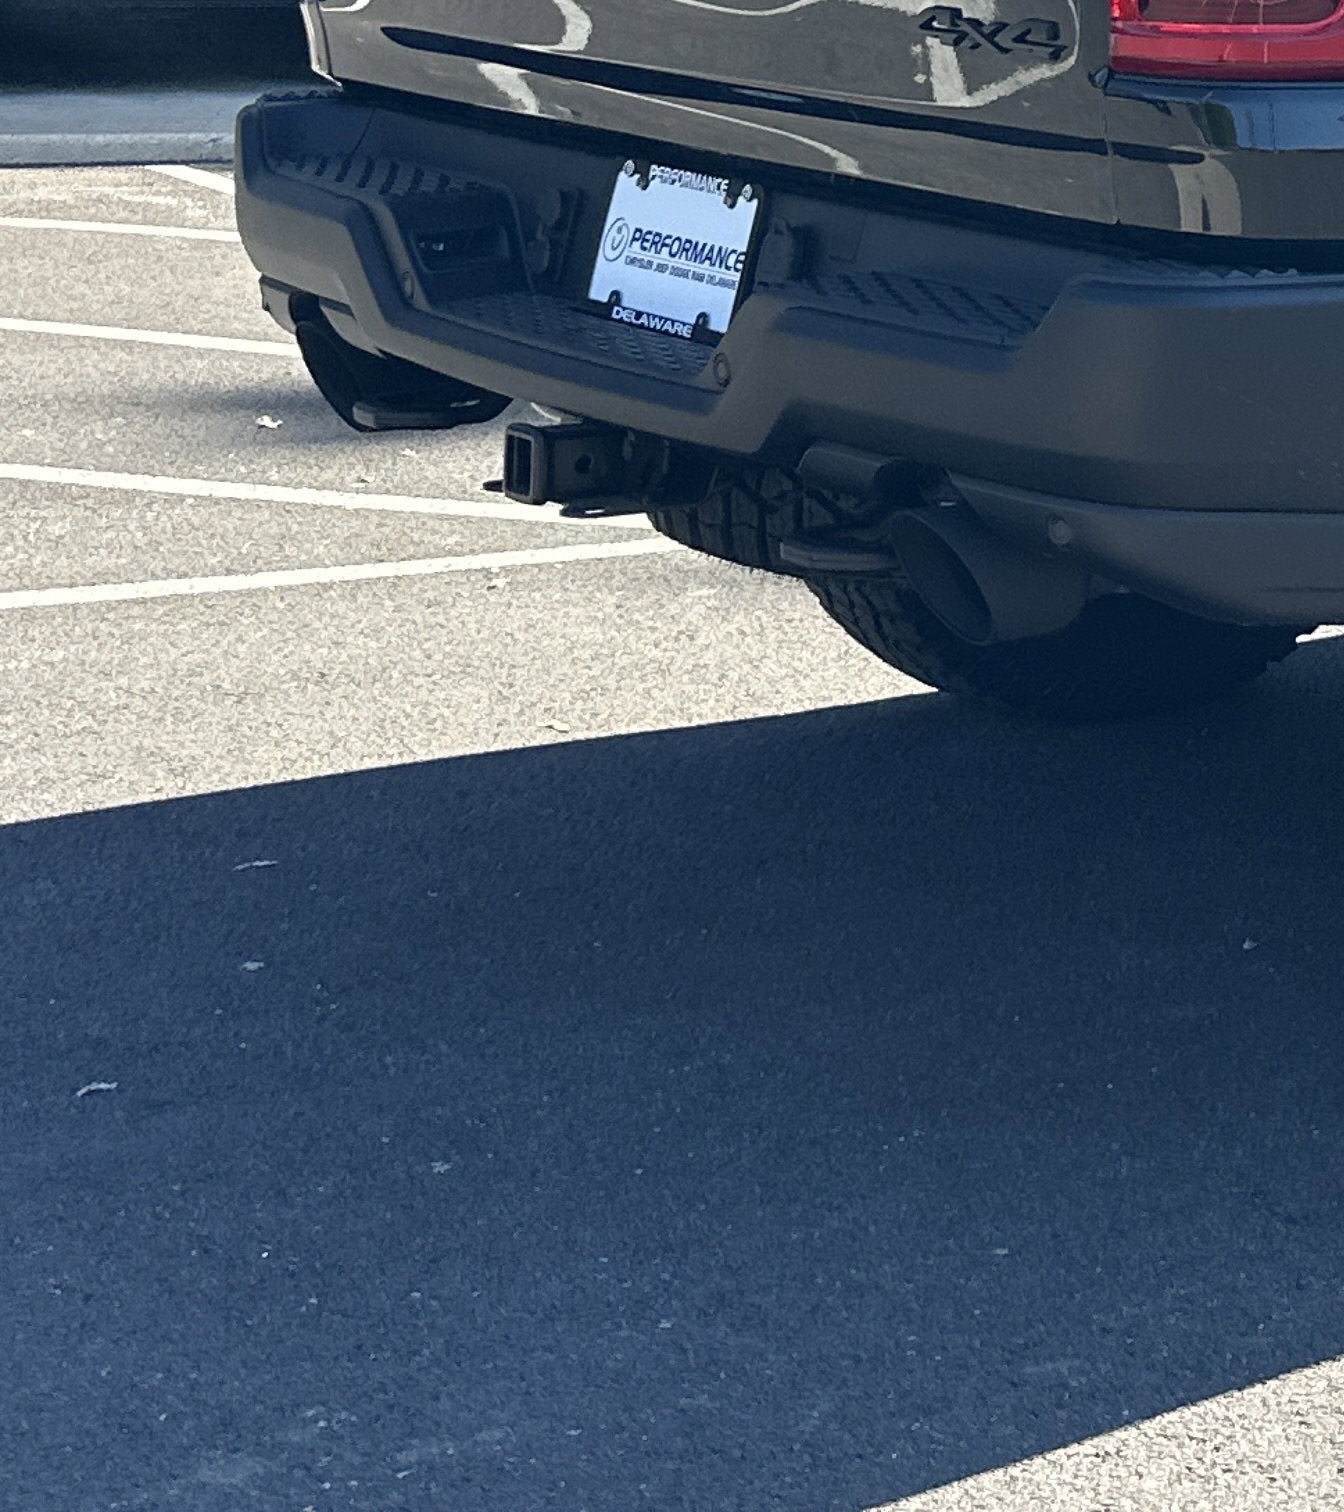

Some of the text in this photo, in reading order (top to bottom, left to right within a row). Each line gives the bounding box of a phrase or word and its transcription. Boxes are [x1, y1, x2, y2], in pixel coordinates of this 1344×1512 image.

[650, 164, 729, 197] PERFORMANCE
[629, 228, 748, 272] PERFORMANCE
[611, 306, 693, 338] DELAWARE
